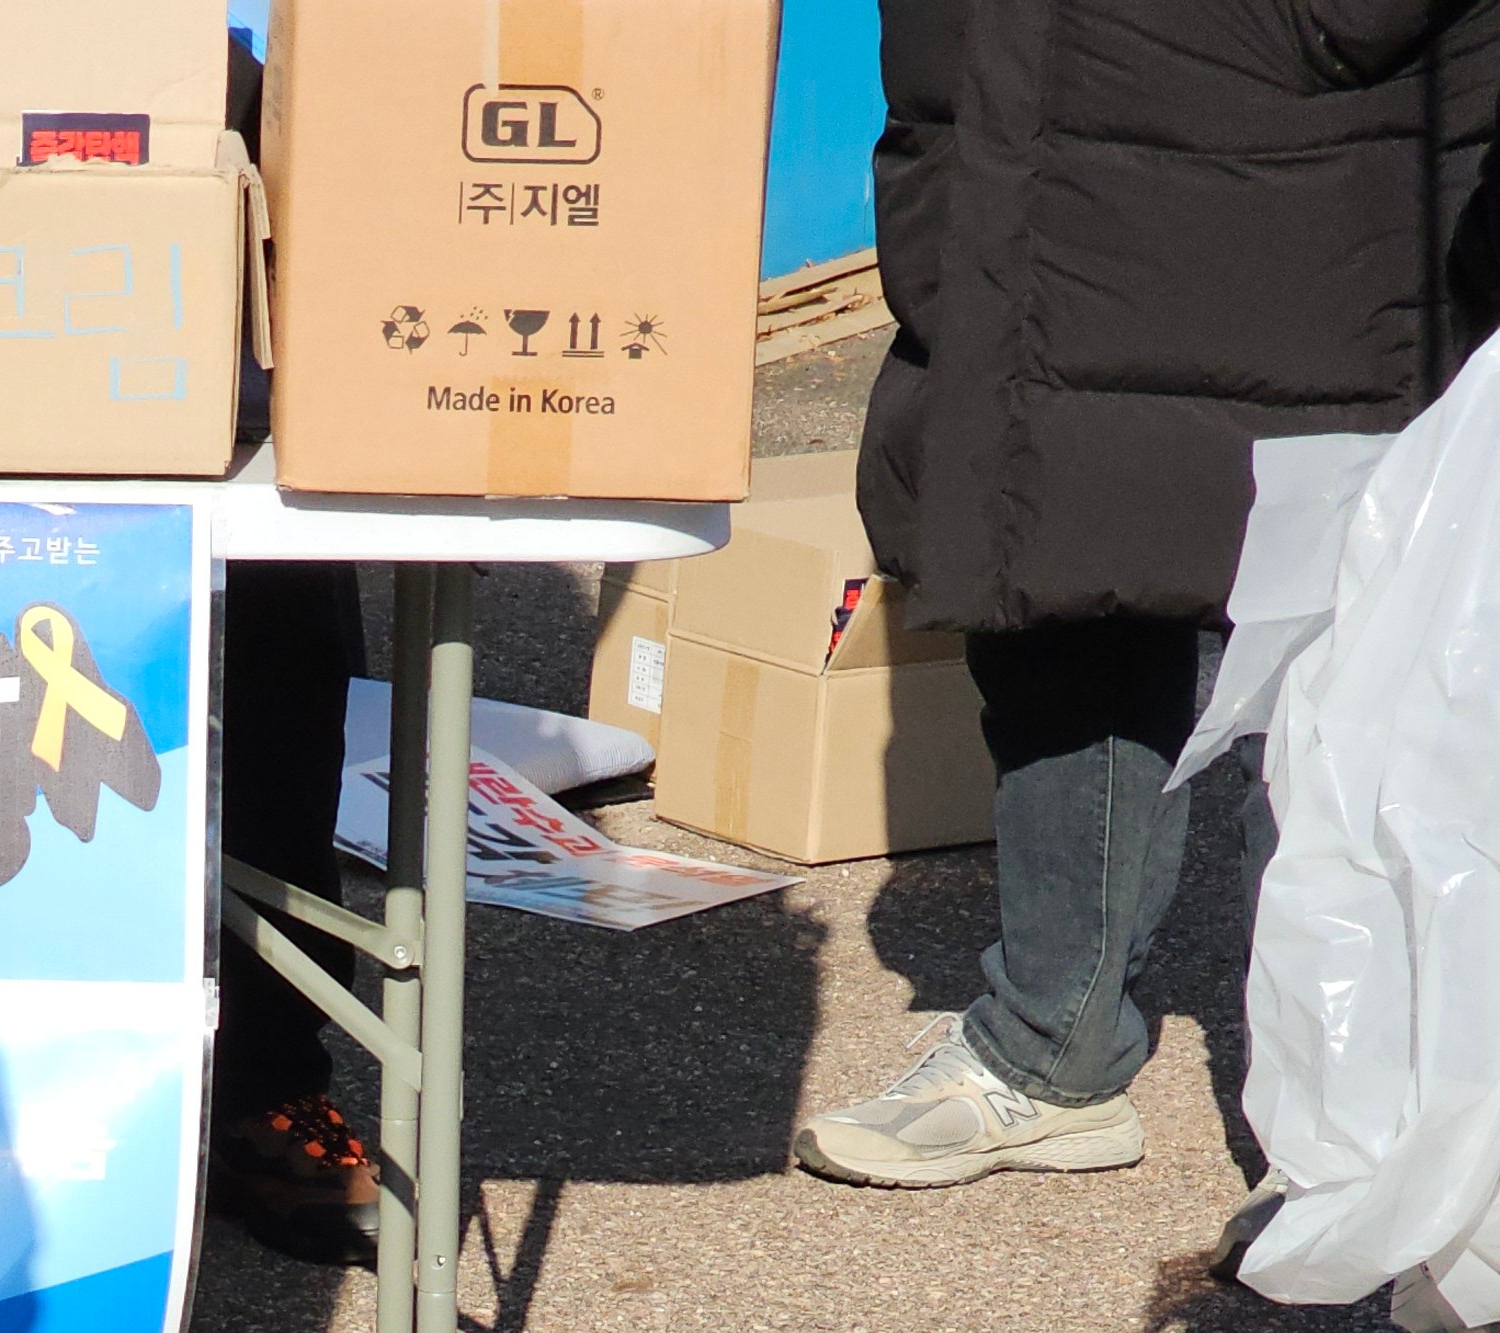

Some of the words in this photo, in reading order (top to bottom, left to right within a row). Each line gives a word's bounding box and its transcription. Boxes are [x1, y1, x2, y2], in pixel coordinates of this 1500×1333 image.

[482, 101, 577, 147] GL
[427, 386, 500, 412] Made
[509, 386, 532, 413] in
[540, 388, 616, 415] Korea
